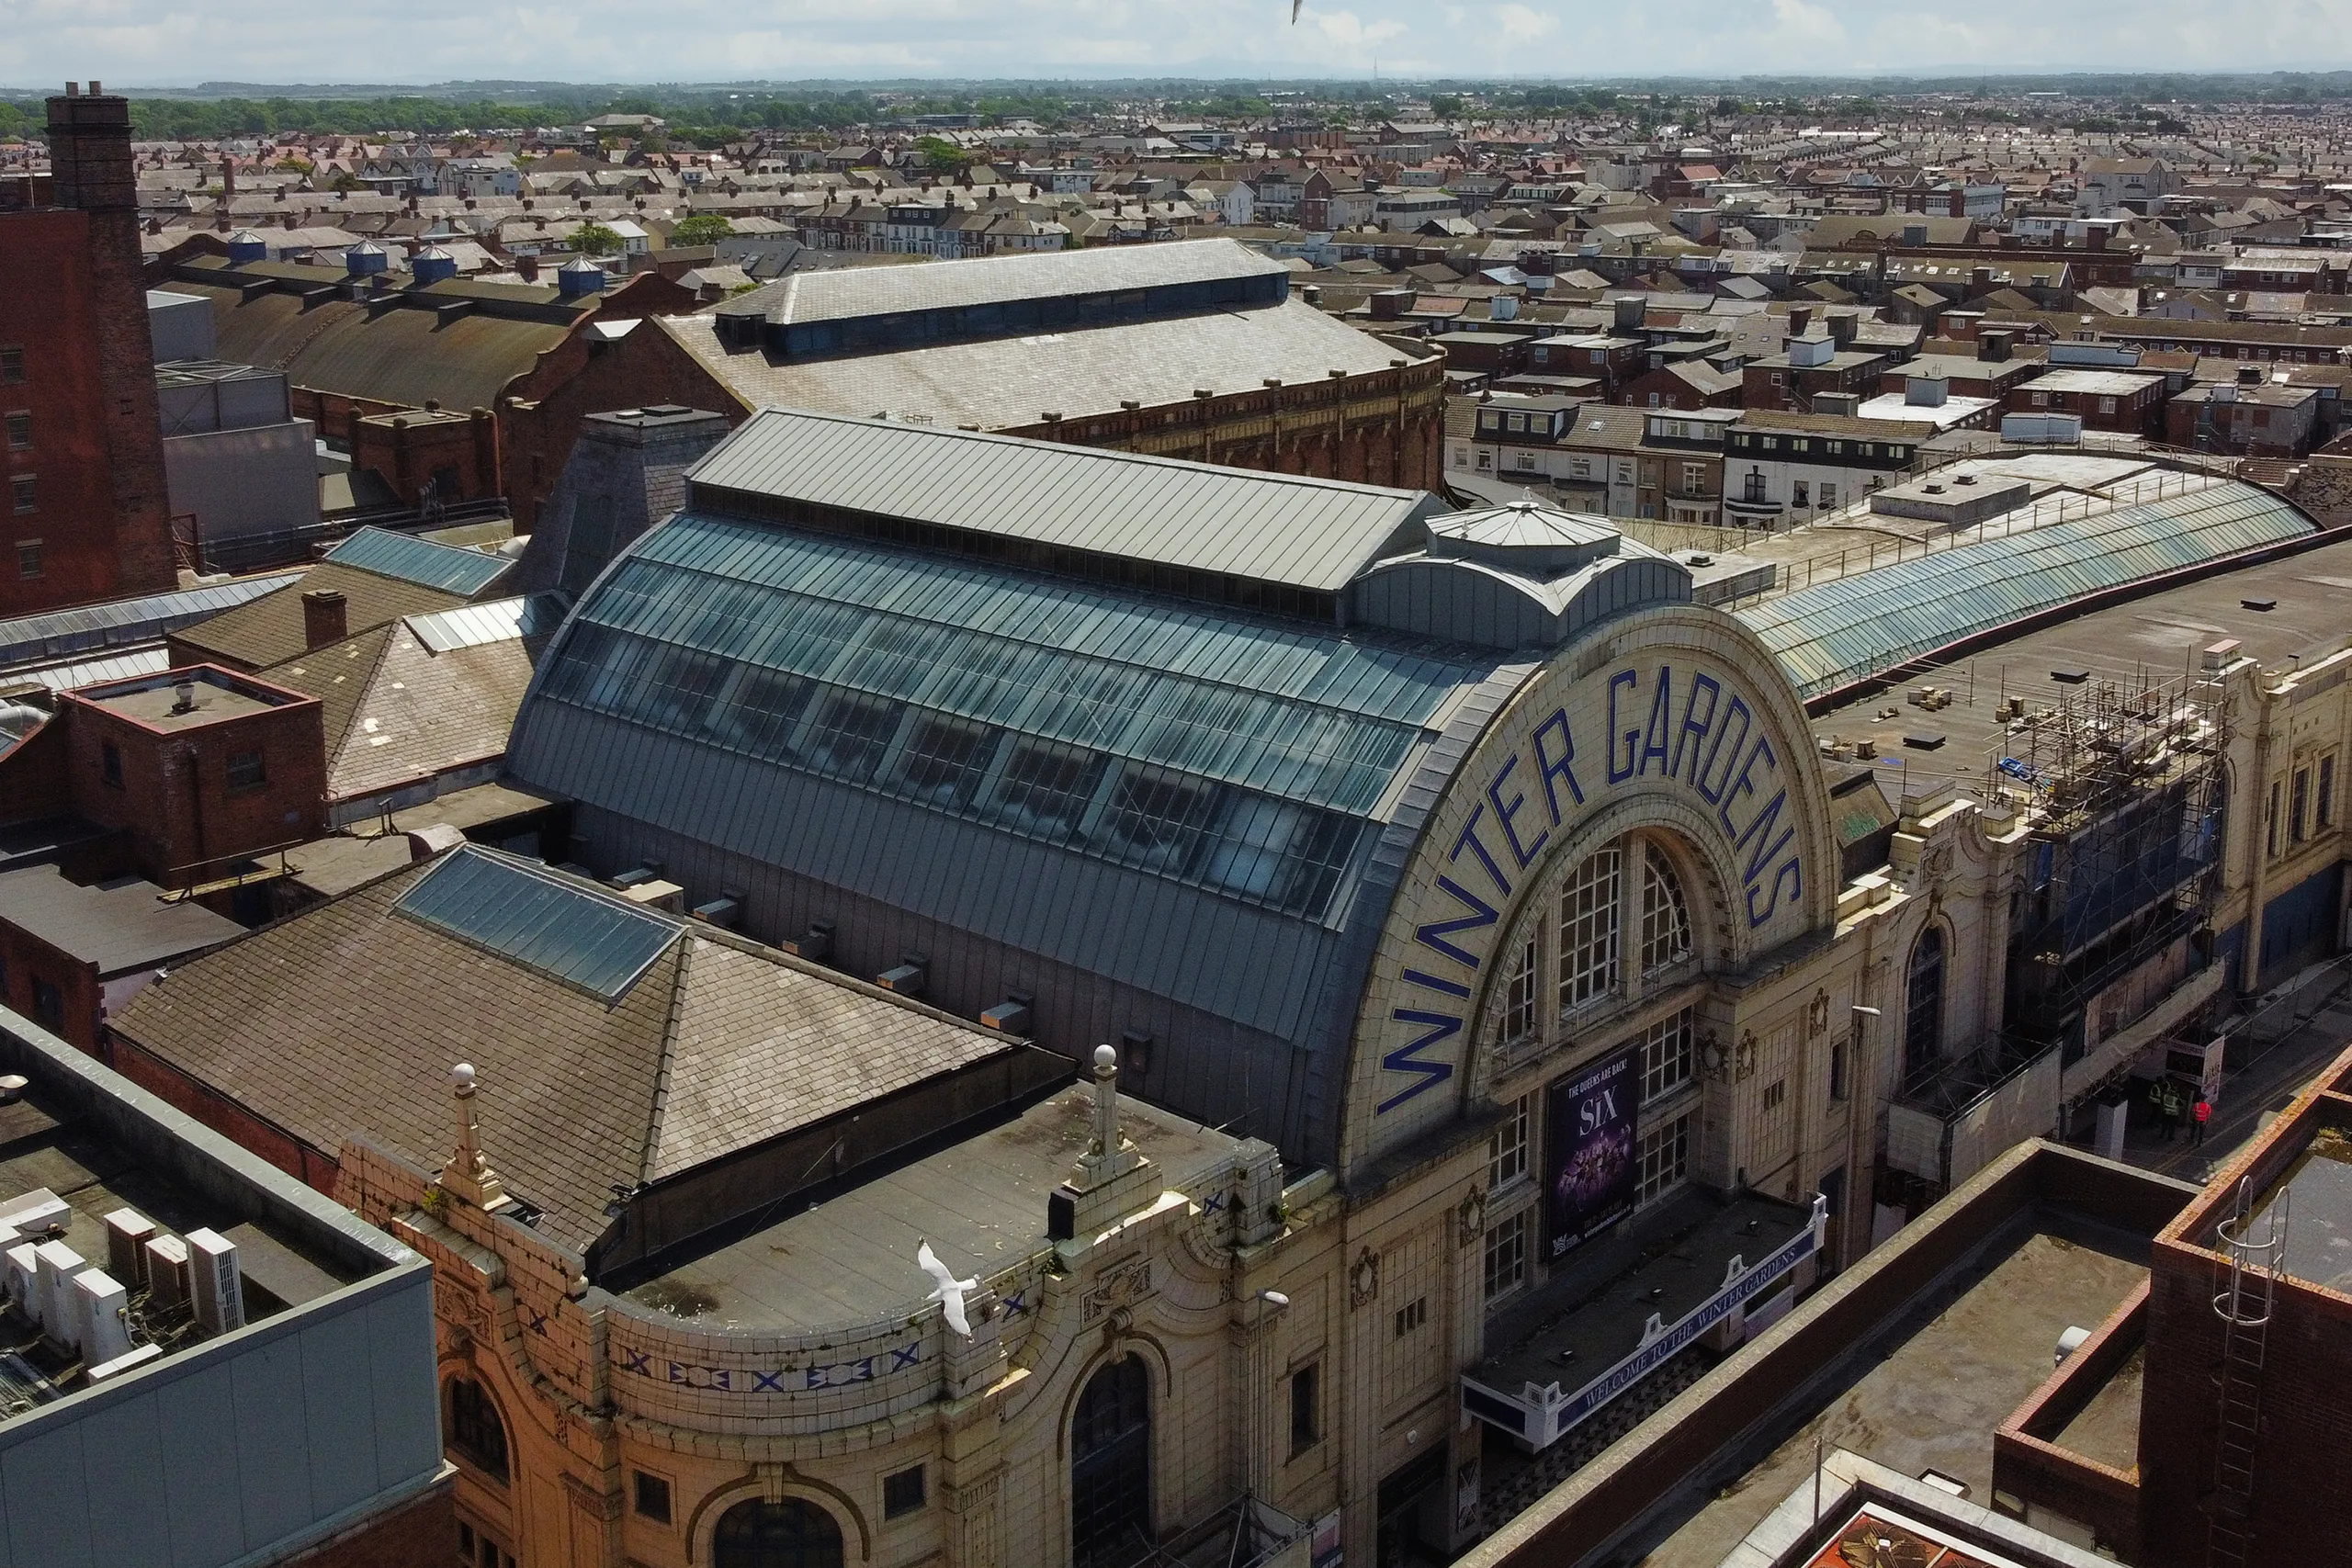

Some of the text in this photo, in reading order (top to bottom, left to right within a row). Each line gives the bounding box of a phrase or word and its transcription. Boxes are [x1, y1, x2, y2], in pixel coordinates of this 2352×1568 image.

[1377, 665, 1802, 1116] WINTER GARDENS
[1568, 1057, 1628, 1099] THE QUEENS ARE BACK!
[1586, 1247, 1795, 1408] WELCOME TO THE WINTER GARDENS
